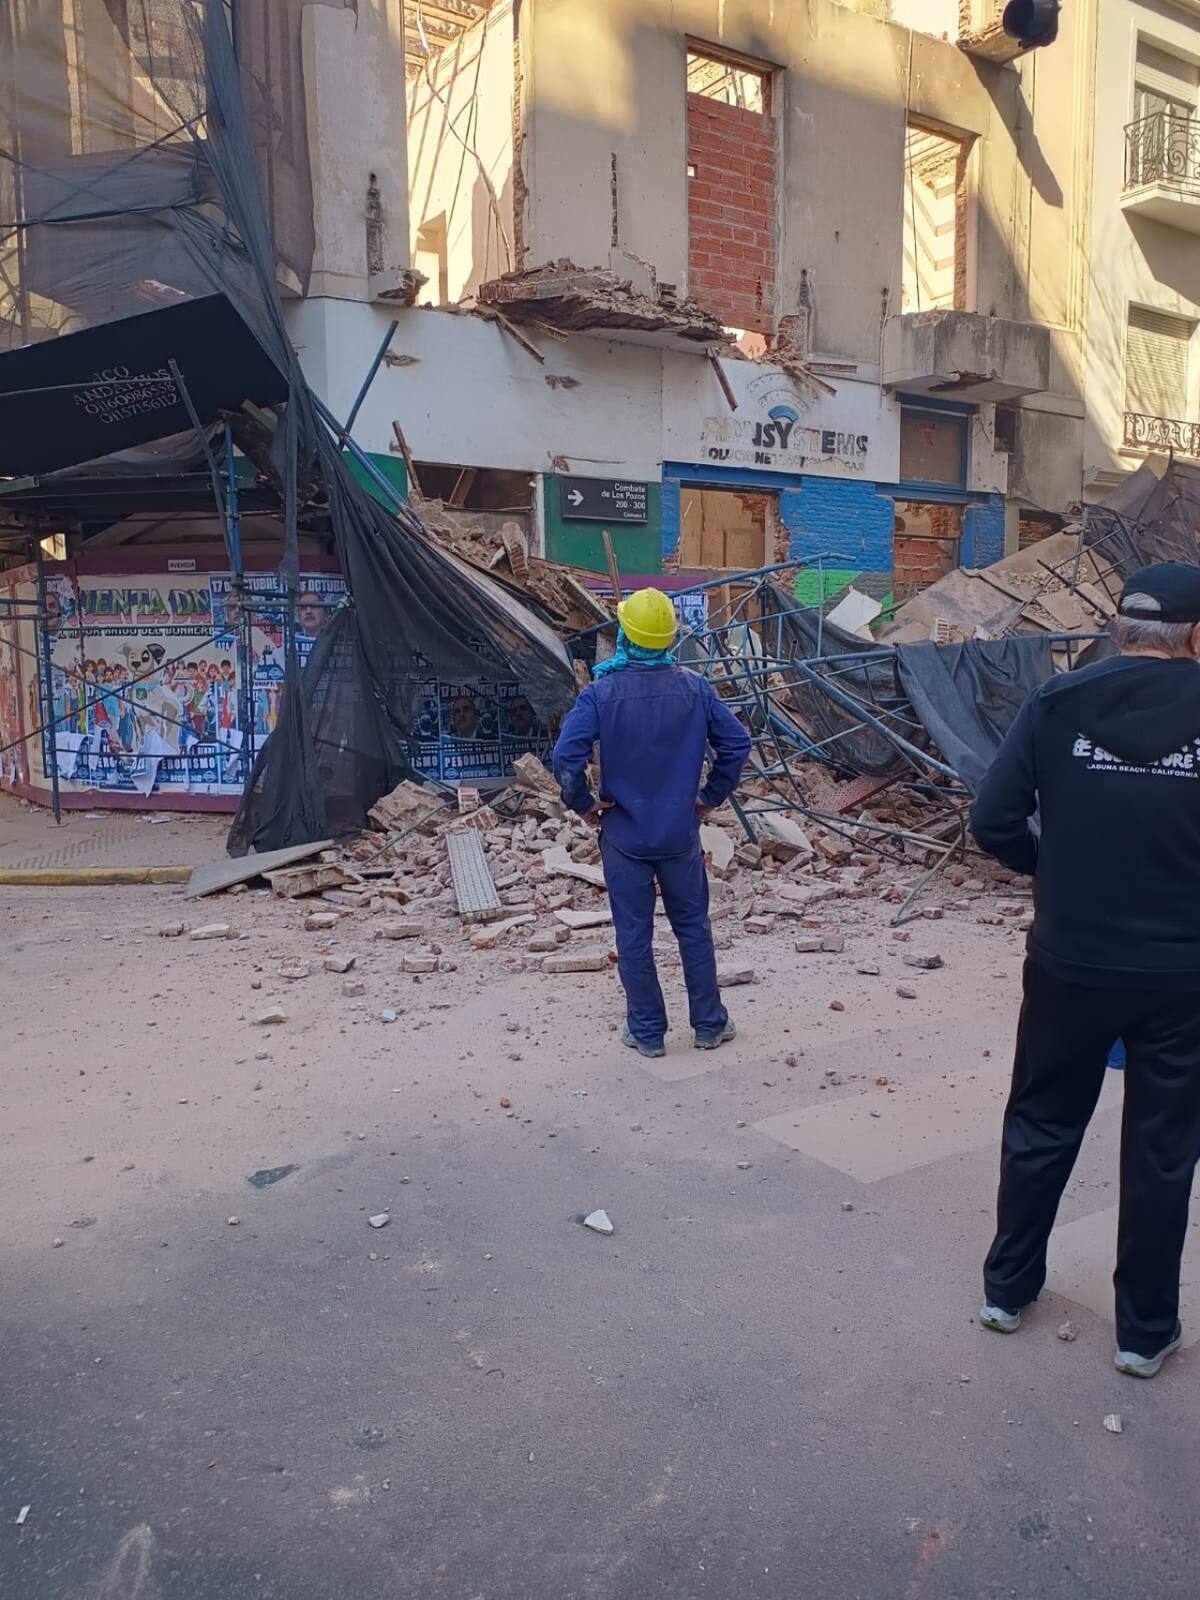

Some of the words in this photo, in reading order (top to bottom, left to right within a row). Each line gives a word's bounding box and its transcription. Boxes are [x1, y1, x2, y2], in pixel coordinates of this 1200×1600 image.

[615, 483, 645, 492] Combate
[601, 490, 610, 498] de
[612, 491, 624, 499] Los
[626, 491, 645, 500] Pozos
[1087, 763, 1117, 771] LAGUNA
[1119, 765, 1146, 773] BEACH
[1151, 768, 1198, 778] CALIFORNIA
